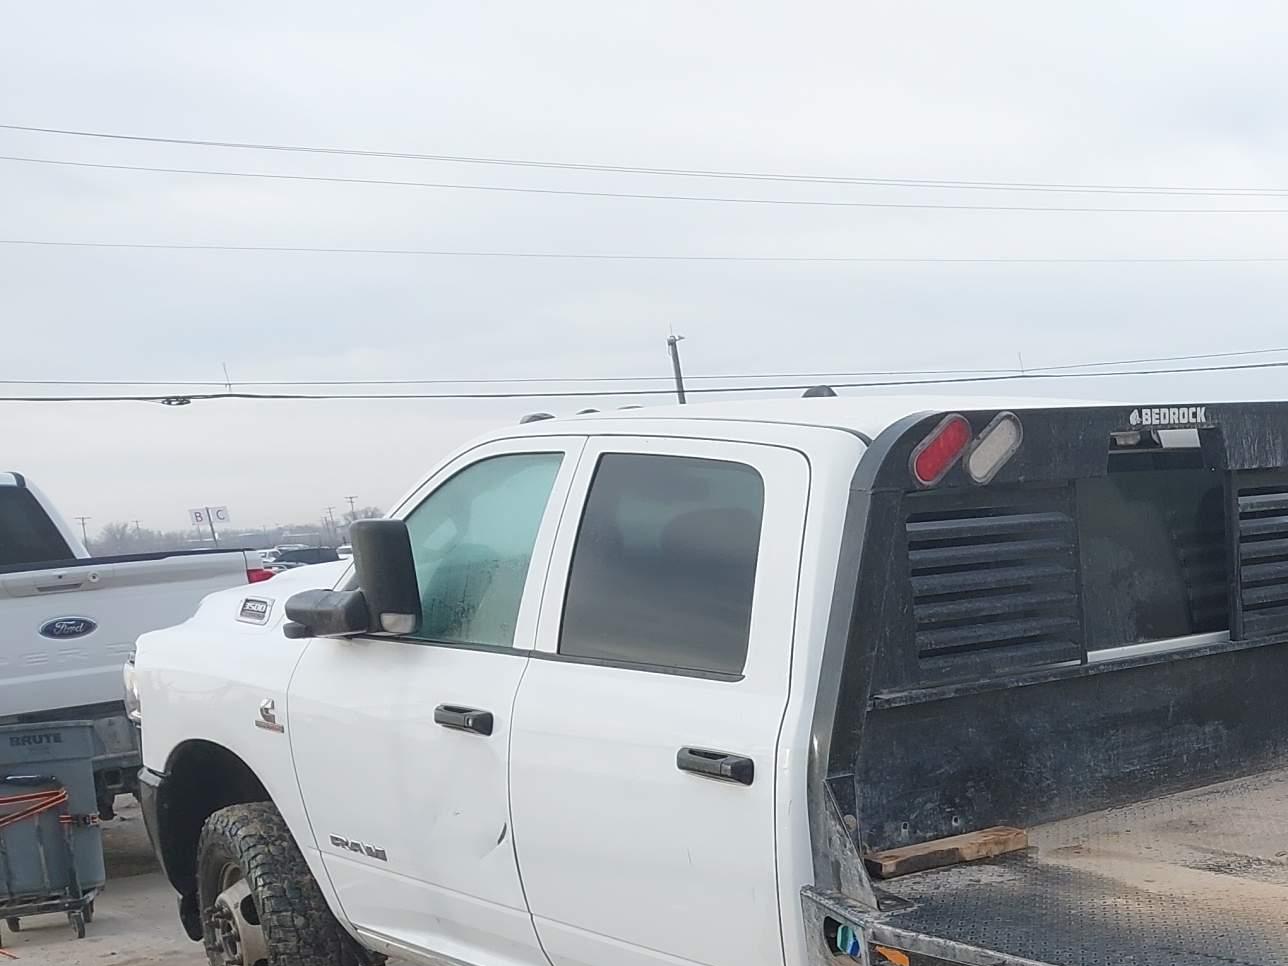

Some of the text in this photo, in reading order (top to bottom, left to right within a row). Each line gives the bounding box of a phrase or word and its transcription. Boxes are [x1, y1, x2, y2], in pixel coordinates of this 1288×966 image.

[1141, 406, 1207, 426] BEDROCK
[194, 511, 204, 522] B
[215, 509, 226, 520] C
[53, 620, 85, 635] Ford
[8, 732, 63, 748] BRUTE
[328, 833, 389, 862] RAM
